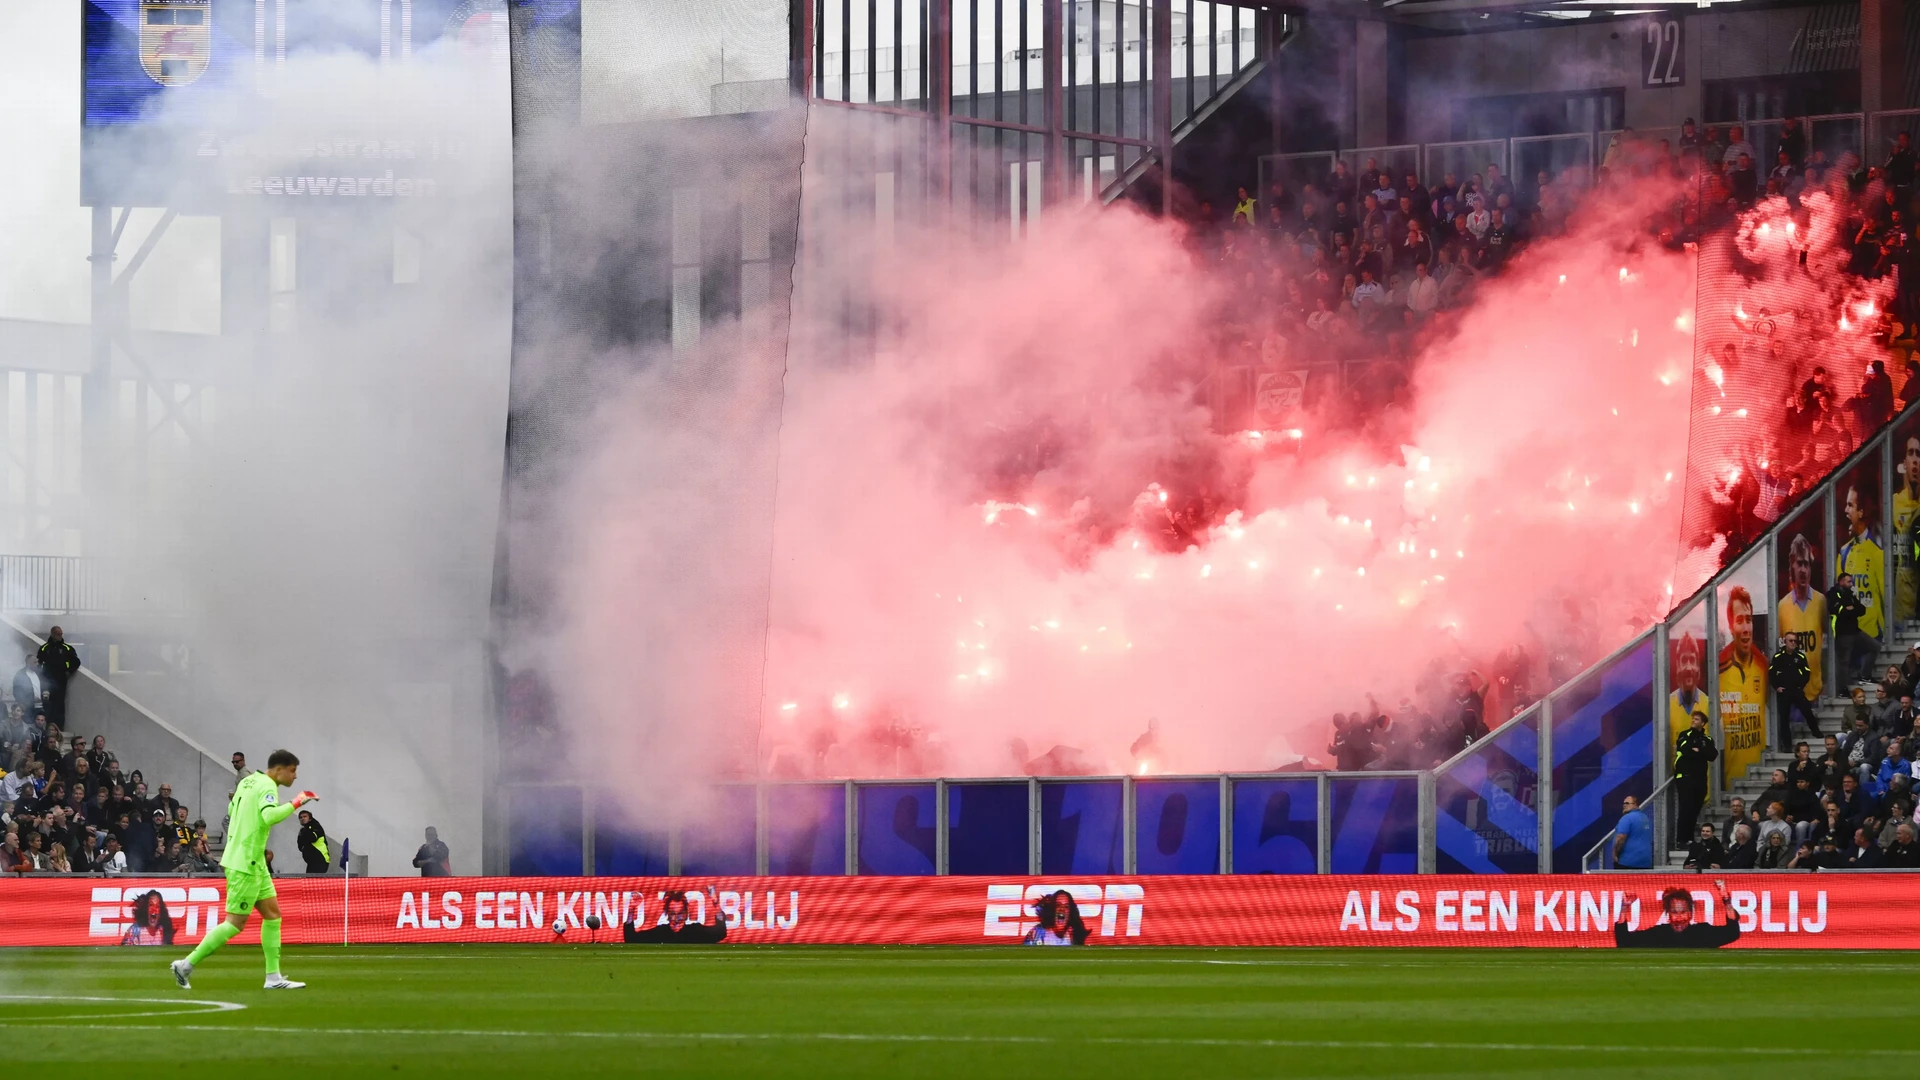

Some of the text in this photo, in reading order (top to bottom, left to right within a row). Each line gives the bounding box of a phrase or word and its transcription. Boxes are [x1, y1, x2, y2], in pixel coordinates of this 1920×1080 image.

[1648, 21, 1680, 84] 22
[227, 169, 435, 197] Leeuwarden
[1730, 731, 1761, 751] DRAISMA
[1475, 836, 1538, 854] TRIBUN
[396, 891, 463, 929] ALS
[475, 891, 544, 929] EEN
[557, 891, 645, 929] KIND
[719, 891, 798, 929] BLIJ
[1339, 890, 1420, 932] ALS
[1436, 890, 1518, 932] EEN
[1731, 890, 1827, 933] BLIJ
